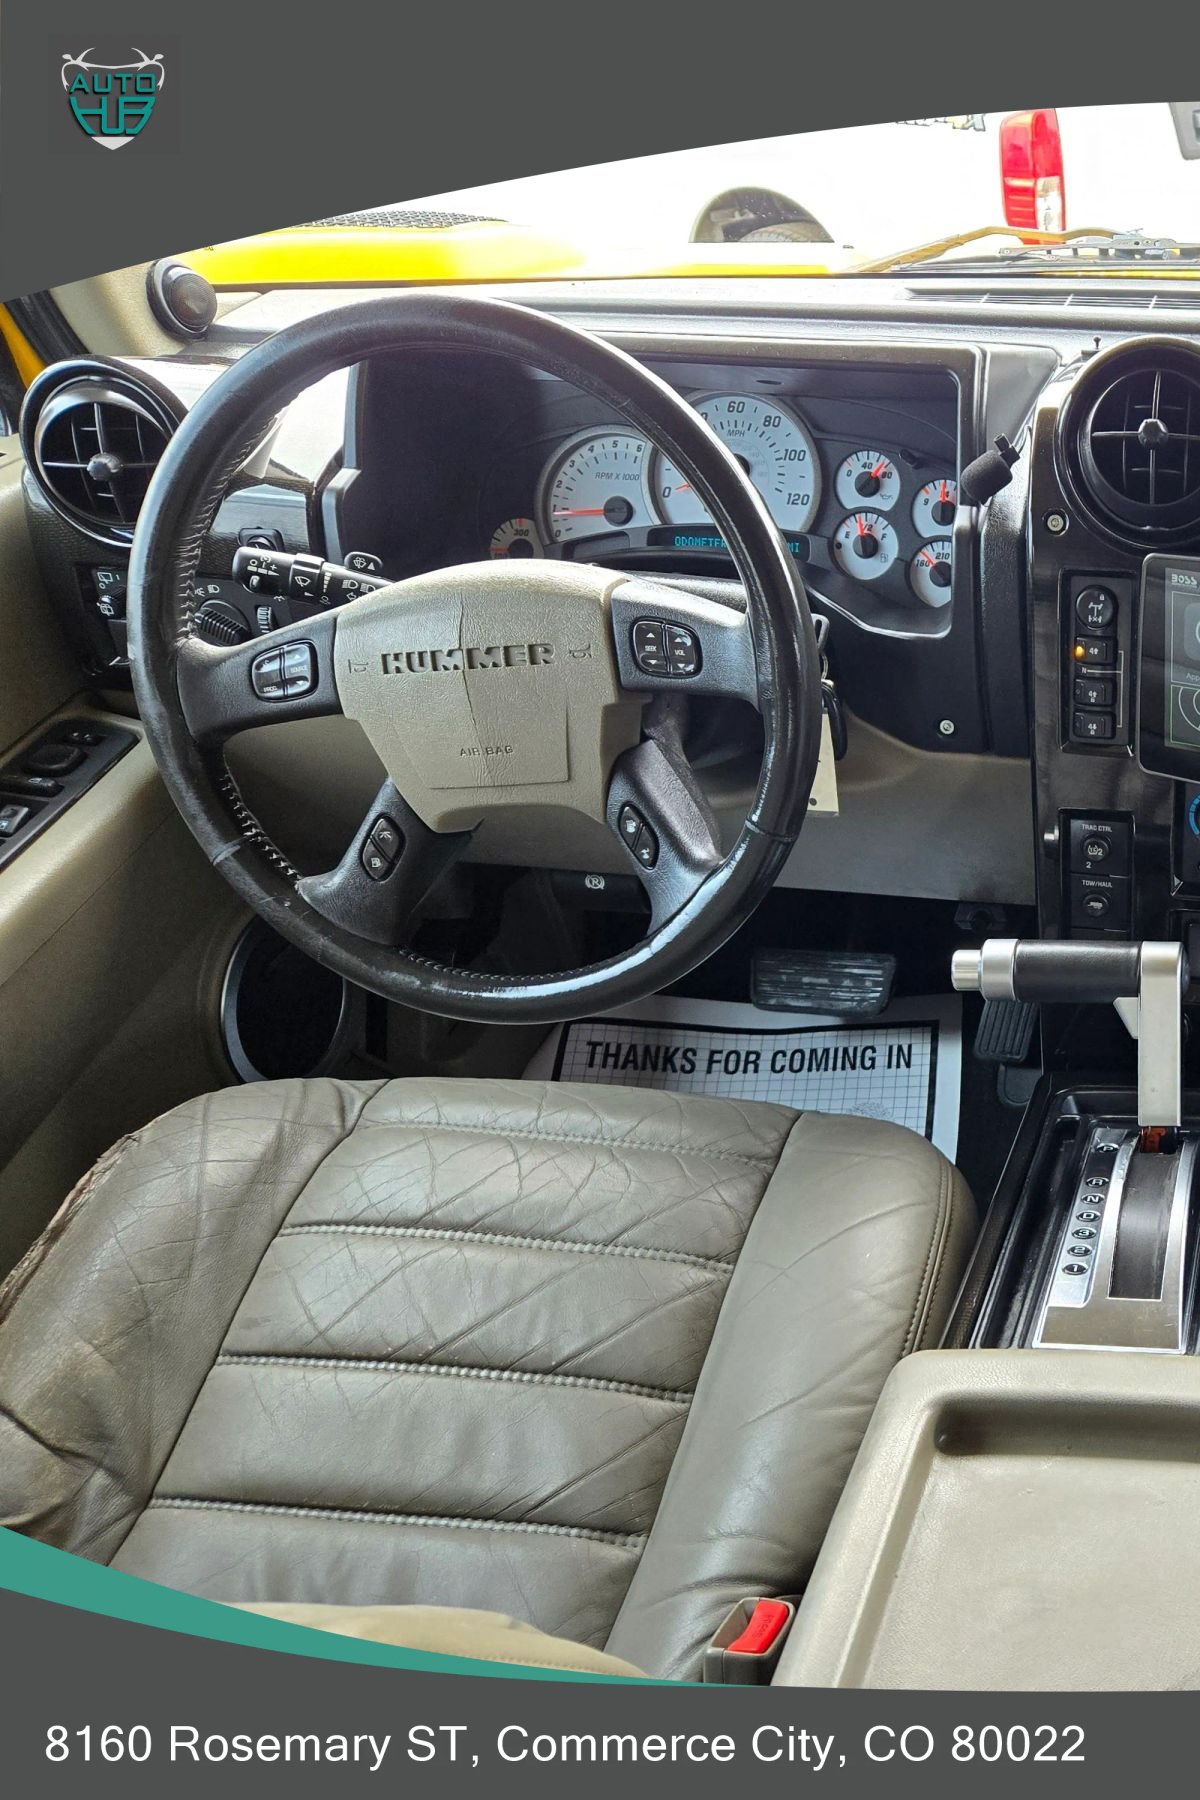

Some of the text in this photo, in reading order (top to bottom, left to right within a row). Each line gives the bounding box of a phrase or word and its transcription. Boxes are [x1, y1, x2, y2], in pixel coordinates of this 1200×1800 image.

[727, 401, 745, 414] 60
[763, 415, 781, 428] 80
[727, 429, 745, 437] MPH
[612, 440, 619, 448] 5
[783, 449, 806, 462] 100
[569, 460, 575, 468] 3
[861, 462, 873, 470] 40
[595, 472, 613, 480] RPM
[622, 473, 640, 481] 1000
[556, 480, 562, 488] 2
[663, 486, 671, 498] 0
[786, 493, 810, 506] 120
[936, 552, 950, 560] 210
[381, 643, 556, 675] HUMMER
[460, 745, 514, 757] AIR BAG
[1082, 880, 1112, 888] TOW/HAUL
[585, 1041, 912, 1075] THANKS FOR COMING IN
